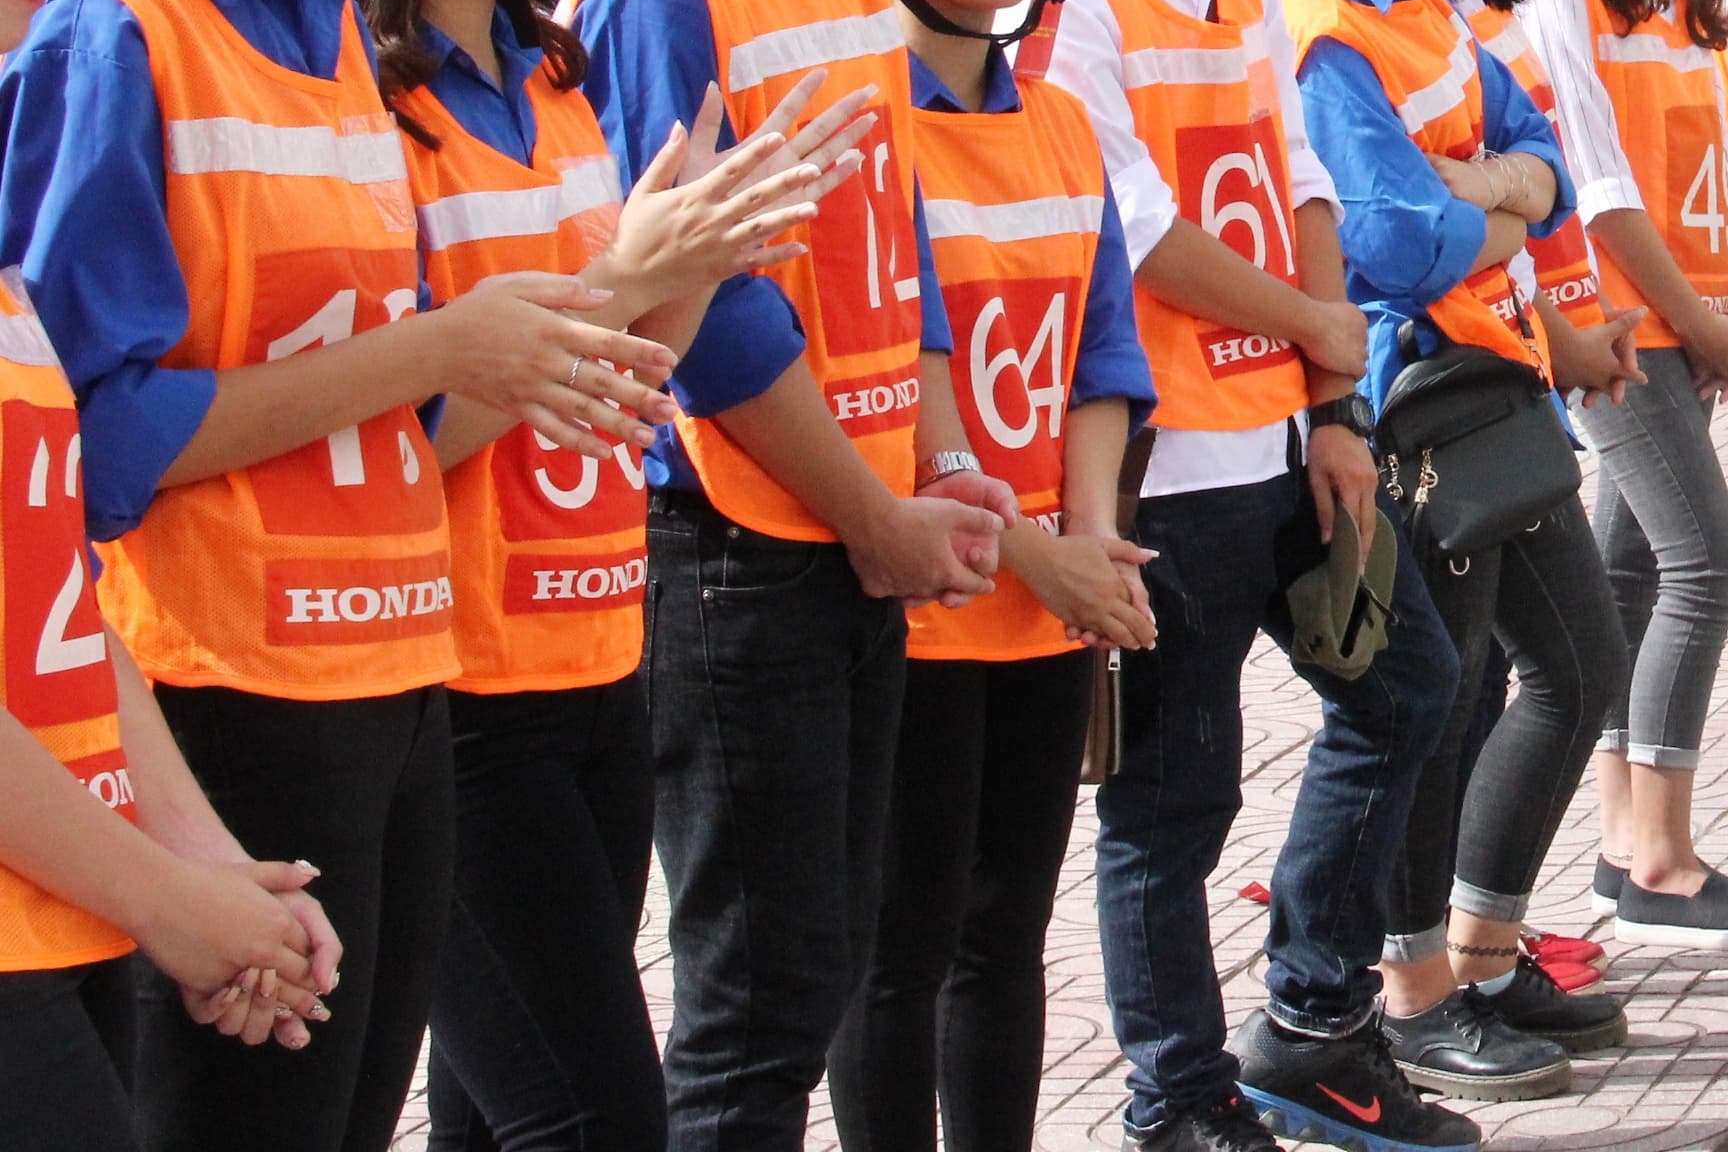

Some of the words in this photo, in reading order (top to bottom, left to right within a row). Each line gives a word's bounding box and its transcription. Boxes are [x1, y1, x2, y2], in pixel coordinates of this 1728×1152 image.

[1201, 143, 1296, 275] 61
[970, 293, 1065, 449] 64
[285, 575, 454, 624] HONDA
[532, 555, 648, 600] HOND
